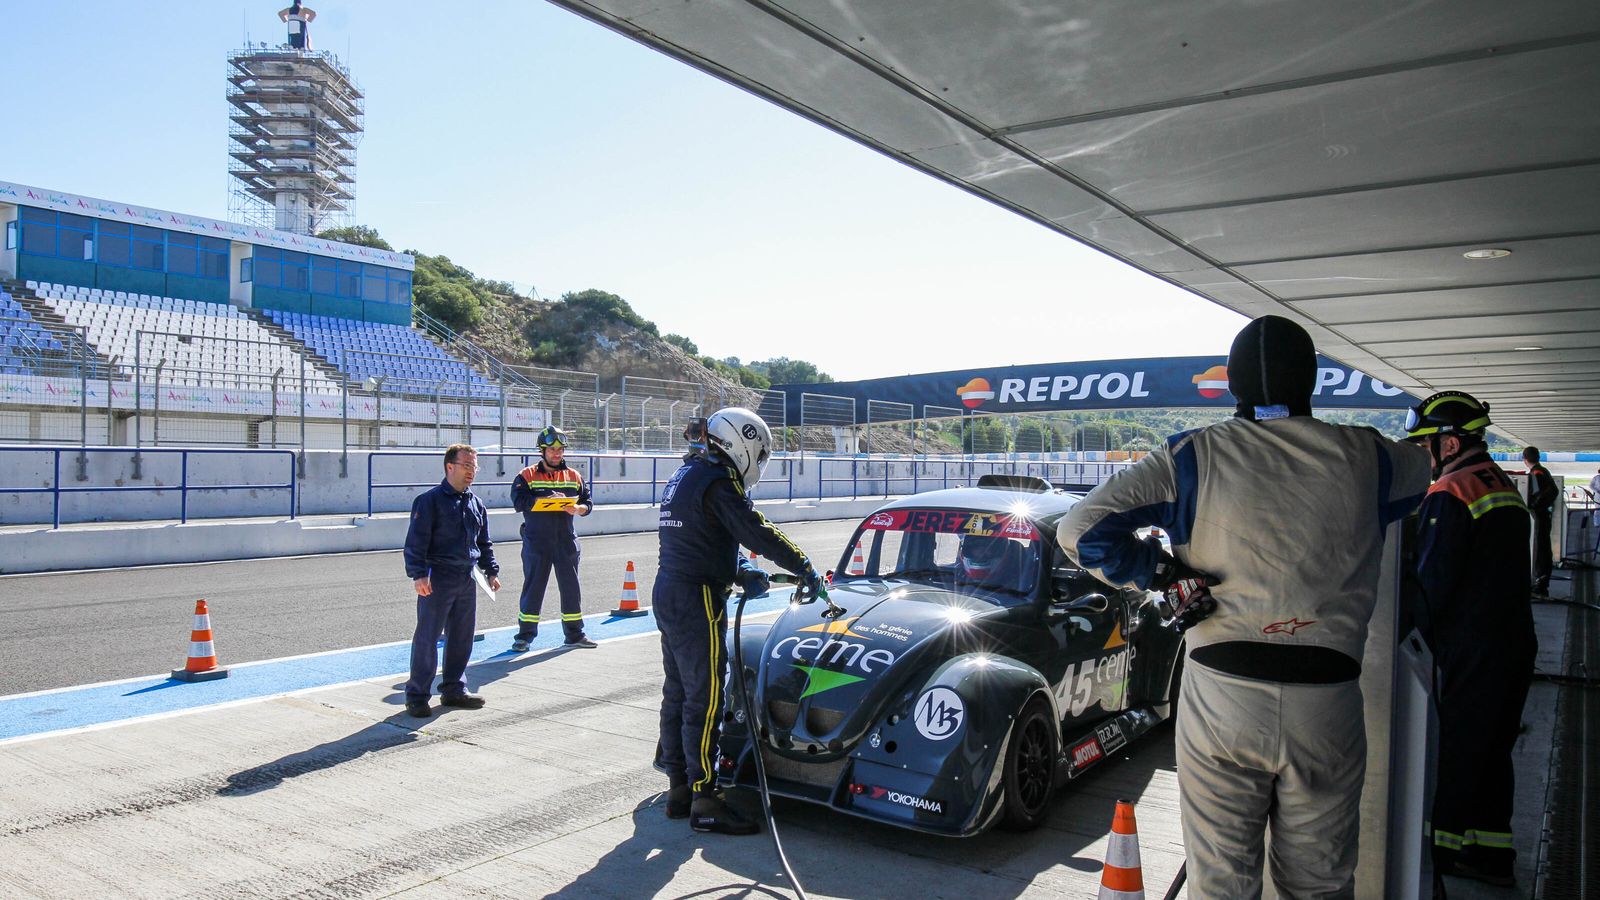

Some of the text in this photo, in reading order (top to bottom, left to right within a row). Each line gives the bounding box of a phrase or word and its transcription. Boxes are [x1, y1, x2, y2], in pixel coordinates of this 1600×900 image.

[999, 371, 1150, 404] REPSOL
[744, 424, 756, 439] 18
[899, 510, 975, 534] JEREZ
[870, 627, 909, 642] hommes
[771, 636, 896, 673] ceme
[1054, 658, 1096, 721] 45
[1075, 741, 1100, 765] MOTUL
[887, 790, 942, 813] YOKOHAMA
